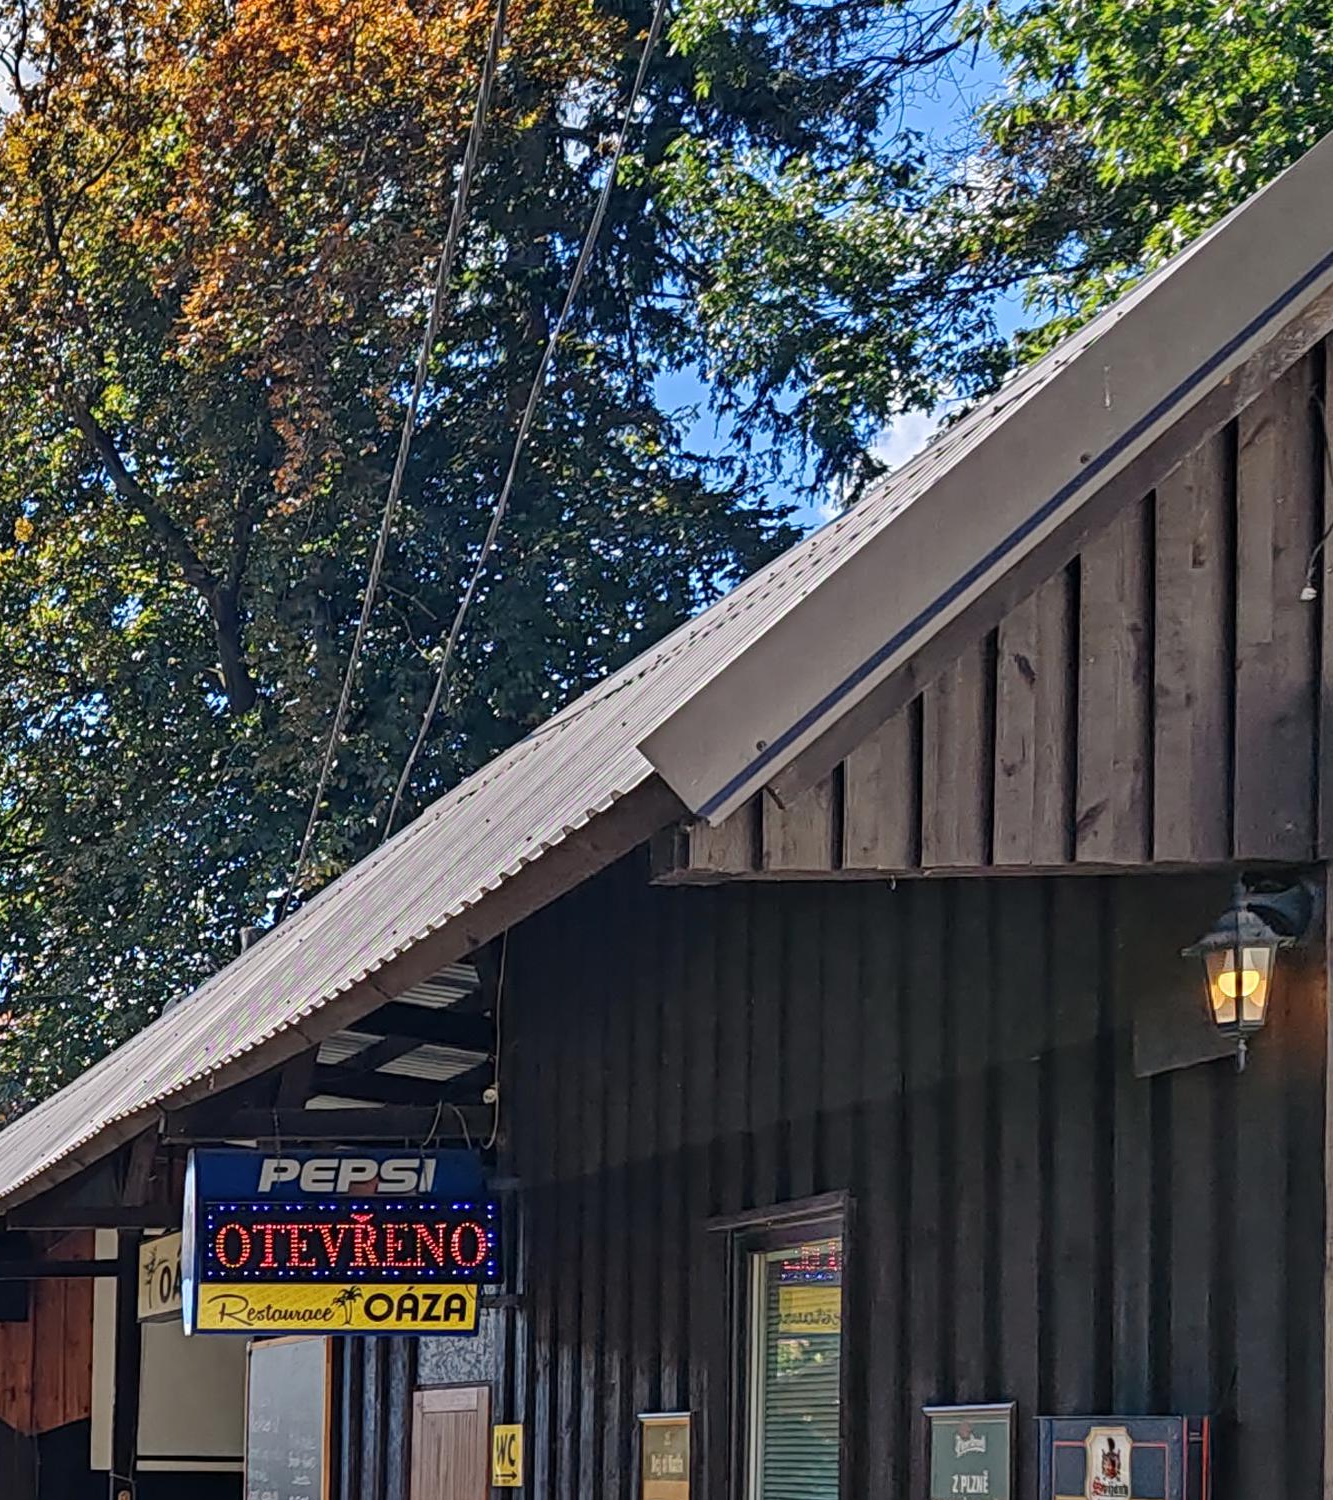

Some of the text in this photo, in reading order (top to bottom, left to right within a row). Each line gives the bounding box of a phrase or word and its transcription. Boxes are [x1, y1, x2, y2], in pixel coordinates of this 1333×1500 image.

[257, 1158, 437, 1193] PEPSI
[214, 1211, 487, 1268] OTEVŘENO
[207, 1285, 467, 1327] Restaurace OÁZA
[495, 1432, 517, 1467] WC
